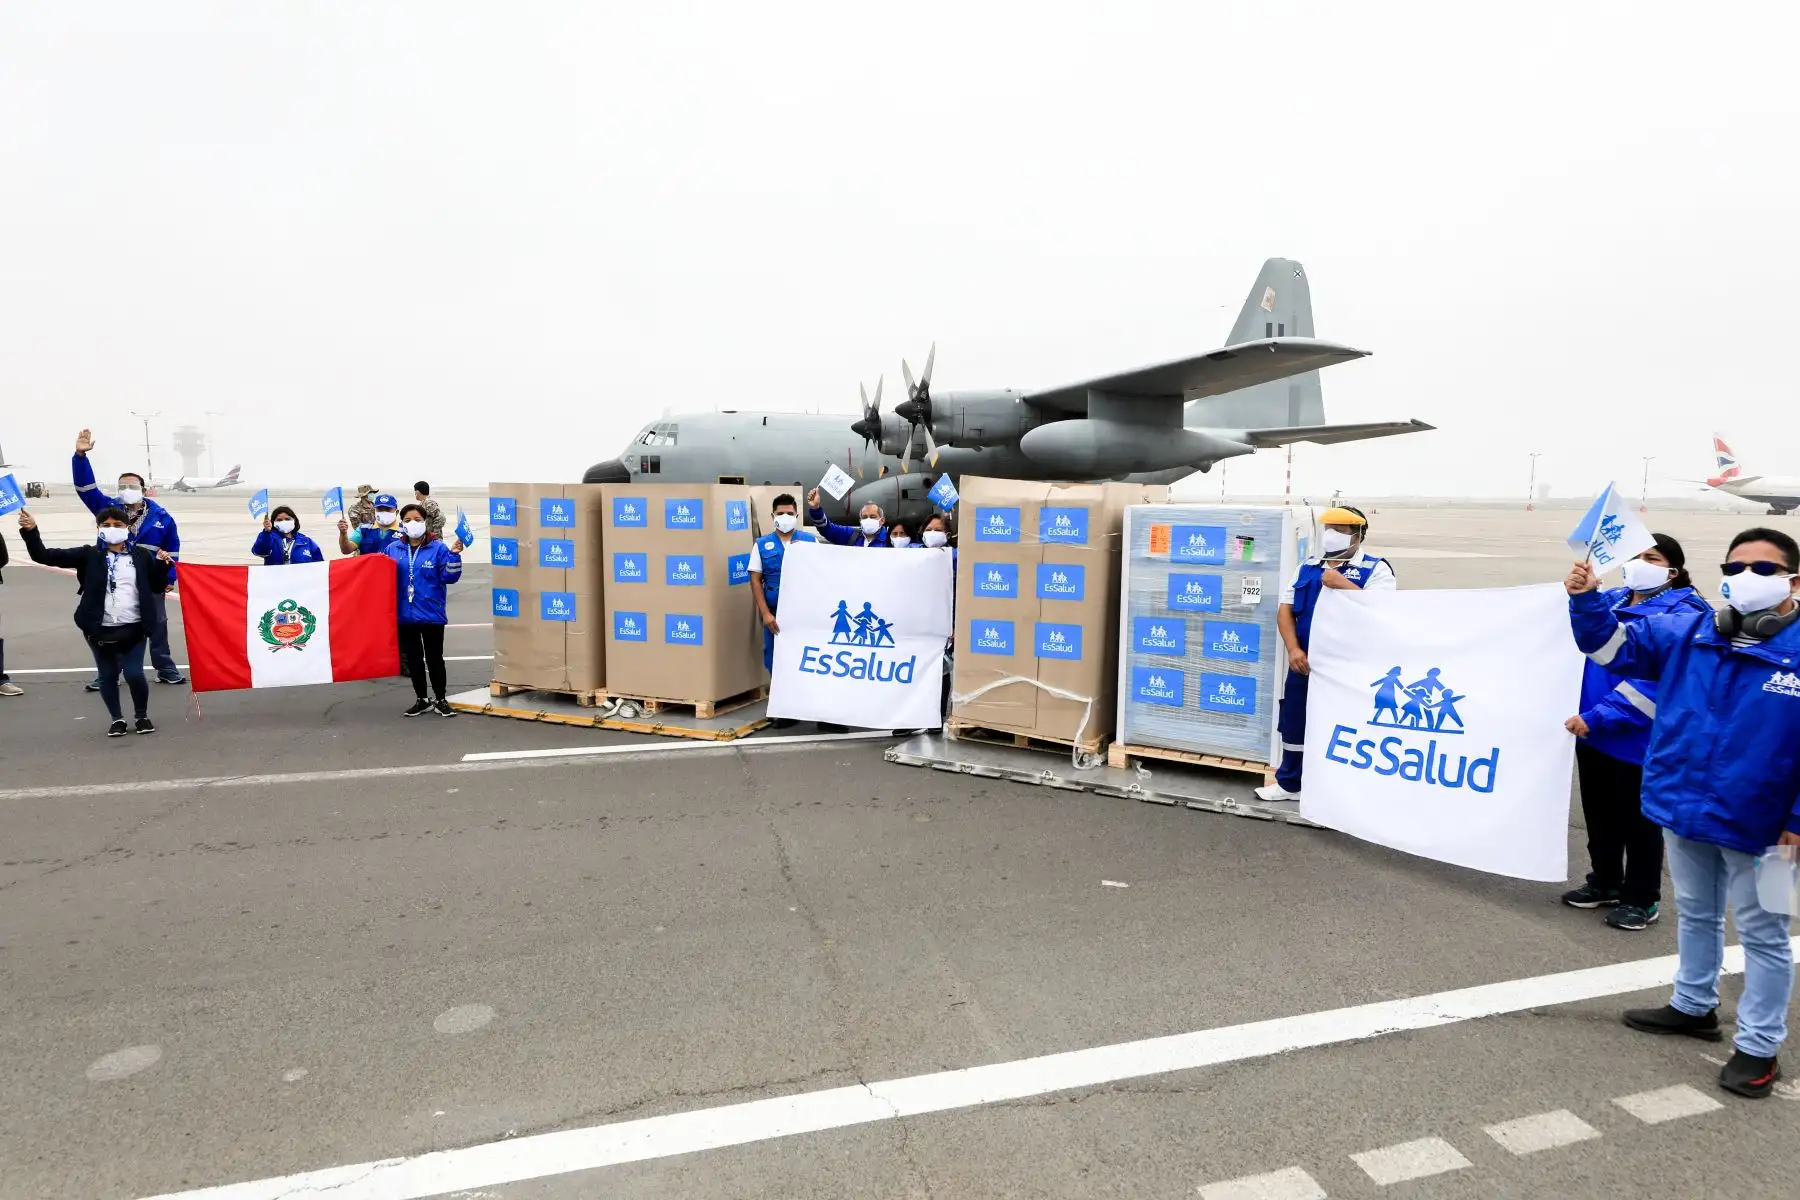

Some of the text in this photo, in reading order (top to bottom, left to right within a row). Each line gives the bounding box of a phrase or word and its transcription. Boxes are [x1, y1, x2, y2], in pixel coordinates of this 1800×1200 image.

[493, 512, 511, 521] EsSalud
[546, 514, 569, 522] EsSalud
[619, 513, 641, 522] EsSalud
[671, 515, 696, 524] EsSalud
[982, 527, 1012, 537] EsSalud
[1047, 527, 1079, 537] EsSalud
[1180, 545, 1215, 557] EsSalud
[494, 552, 512, 561] EsSalud
[545, 554, 568, 563] EsSalud
[619, 568, 641, 577] EsSalud
[672, 571, 697, 580] EsSalud
[981, 582, 1010, 592] EsSalud
[1044, 582, 1076, 593] EsSalud
[1242, 587, 1260, 596] 7922
[1177, 594, 1211, 605] EsSalud
[495, 603, 513, 612] EsSalud
[547, 606, 570, 616] EsSalud
[619, 627, 641, 636] EsSalud
[671, 630, 696, 640] EsSalud
[977, 638, 1006, 648] EsSalud
[1042, 642, 1073, 653] EsSalud
[1142, 637, 1176, 648] EsSalud
[1213, 642, 1248, 654] EsSalud
[799, 646, 916, 684] EsSalud
[1140, 688, 1174, 699] EsSalud
[1762, 683, 1800, 697] EsSalu
[1209, 695, 1245, 706] EsSalud
[1325, 724, 1500, 793] EsSalud
